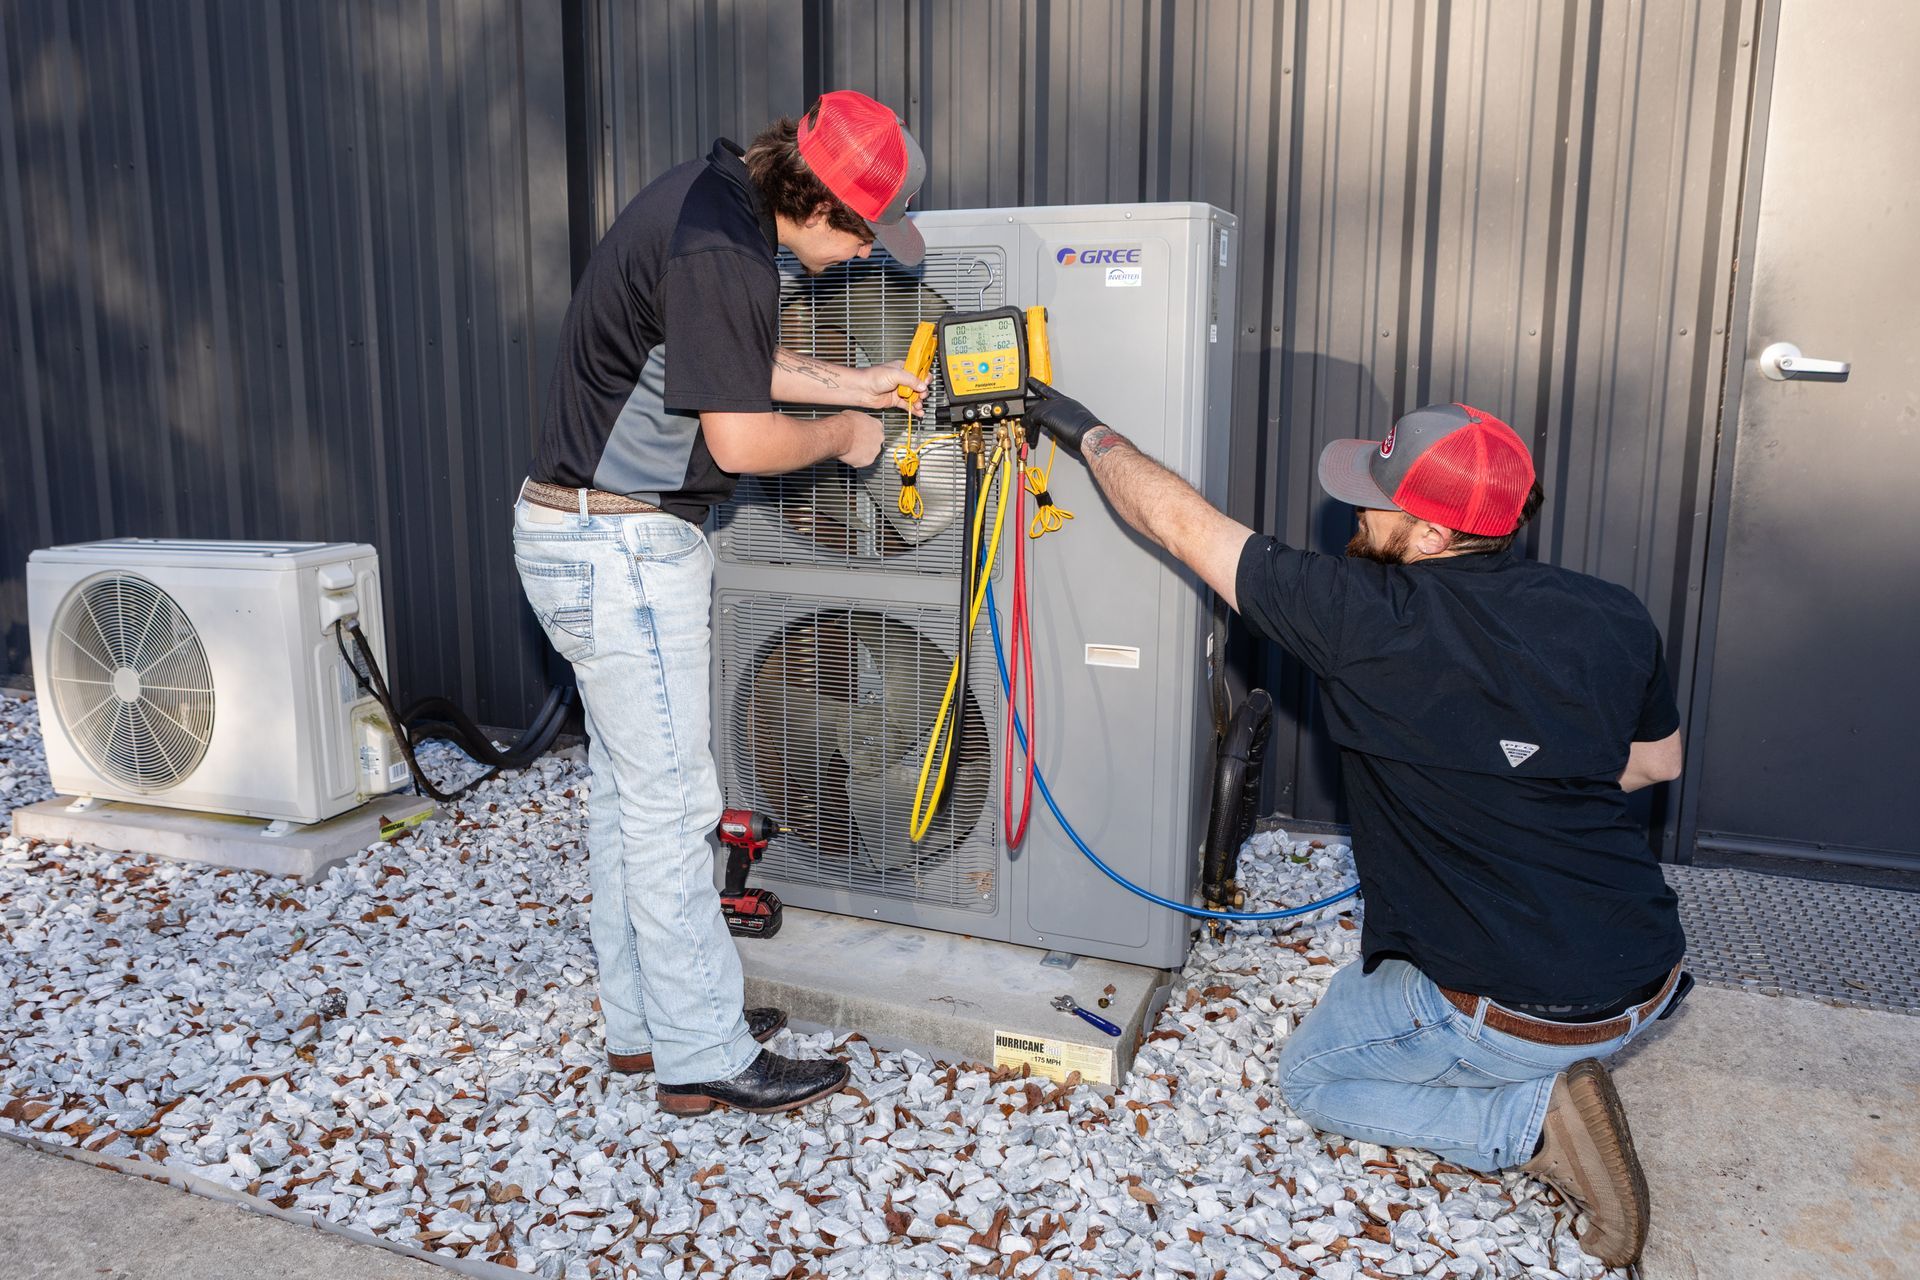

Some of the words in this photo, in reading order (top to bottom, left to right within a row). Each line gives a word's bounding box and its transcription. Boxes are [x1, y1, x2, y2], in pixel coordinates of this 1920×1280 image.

[1080, 248, 1142, 264] GREE
[996, 1035, 1045, 1053] HURRICANE
[1034, 1056, 1046, 1064] 175
[1046, 1058, 1061, 1067] MPH
